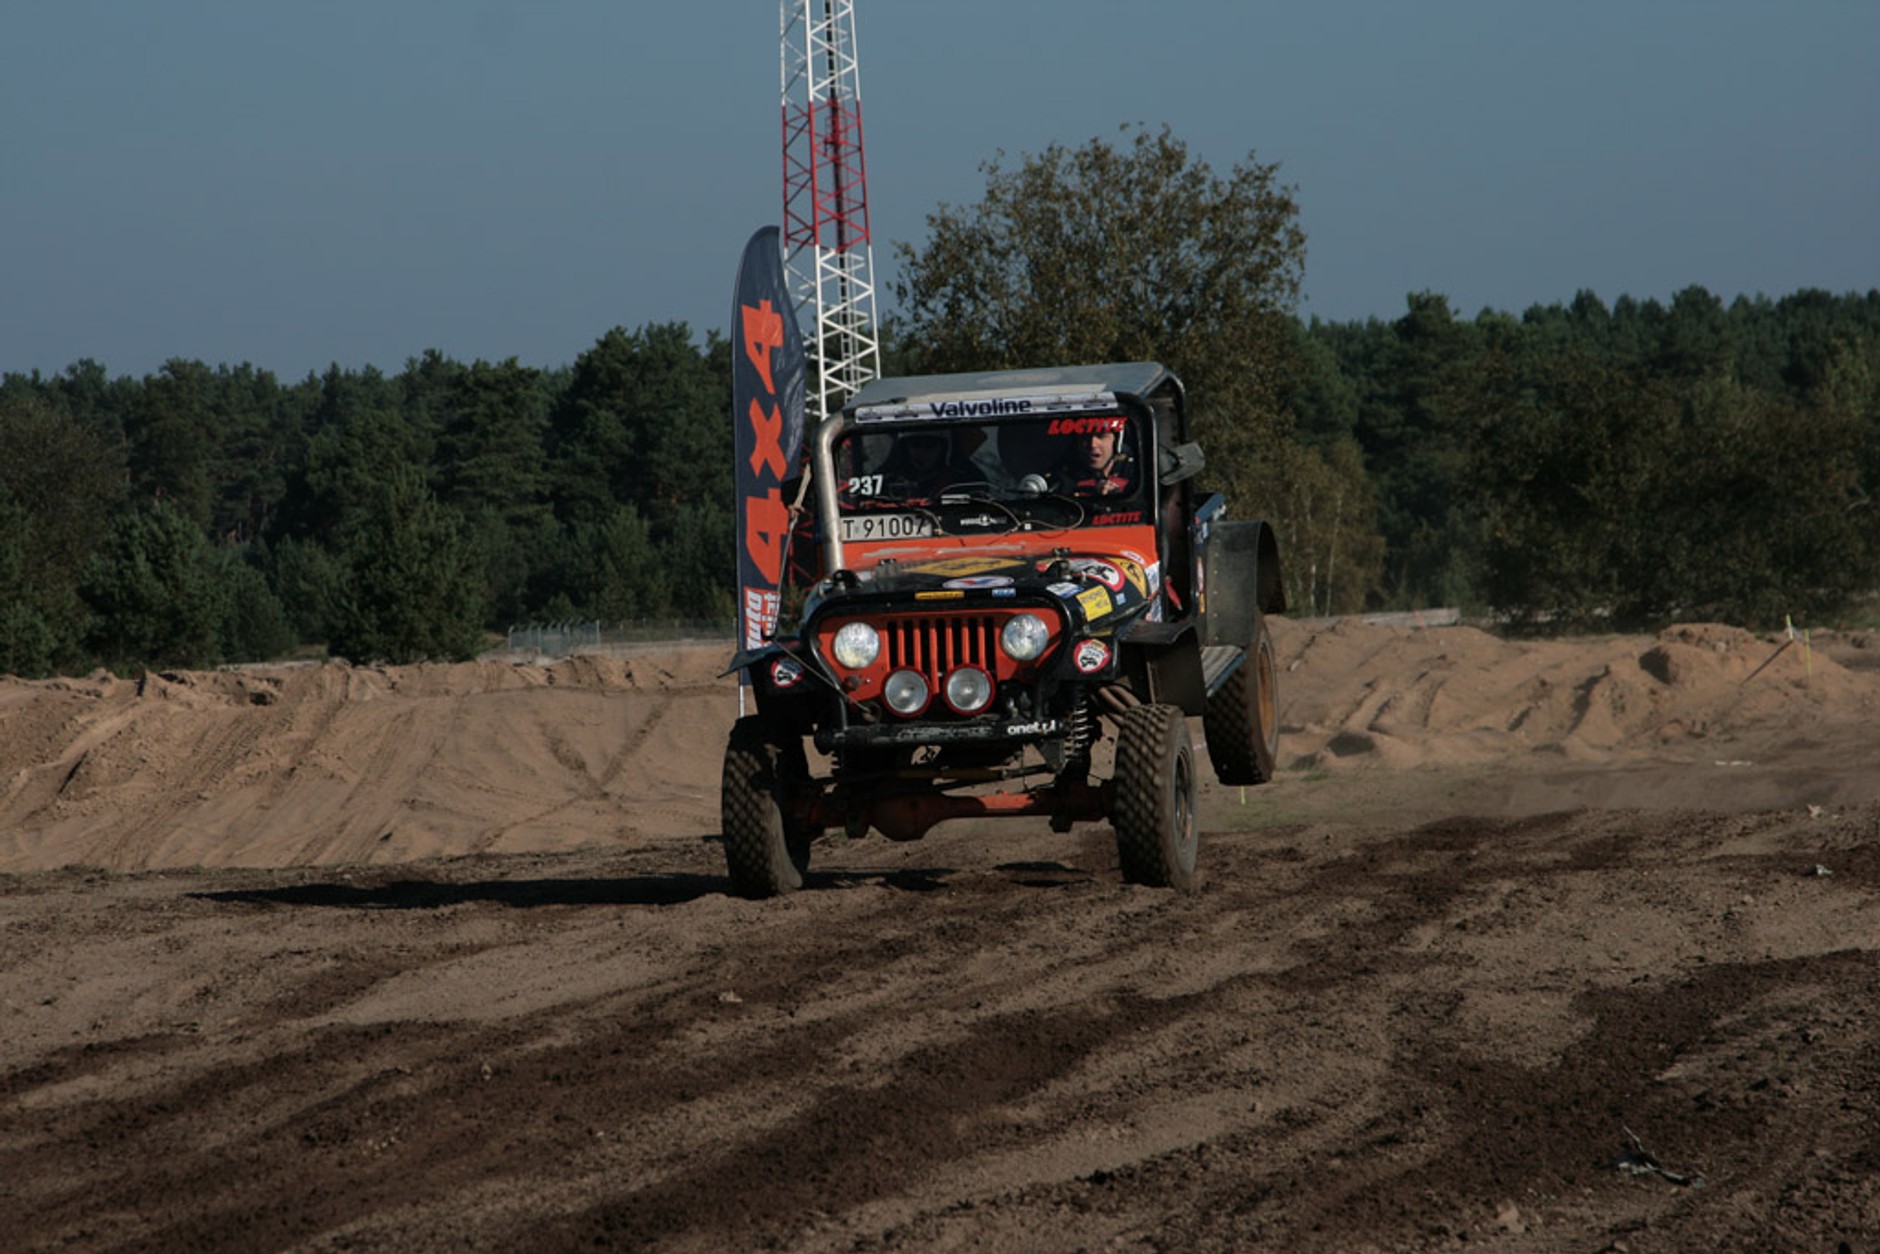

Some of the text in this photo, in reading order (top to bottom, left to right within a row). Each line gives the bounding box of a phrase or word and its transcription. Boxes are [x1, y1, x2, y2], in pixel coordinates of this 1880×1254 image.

[930, 399, 1032, 417] Valvoline
[1048, 417, 1127, 434] LOCTITE
[848, 474, 884, 496] 237
[842, 515, 925, 539] T 91007
[1092, 511, 1142, 525] LOCTITE
